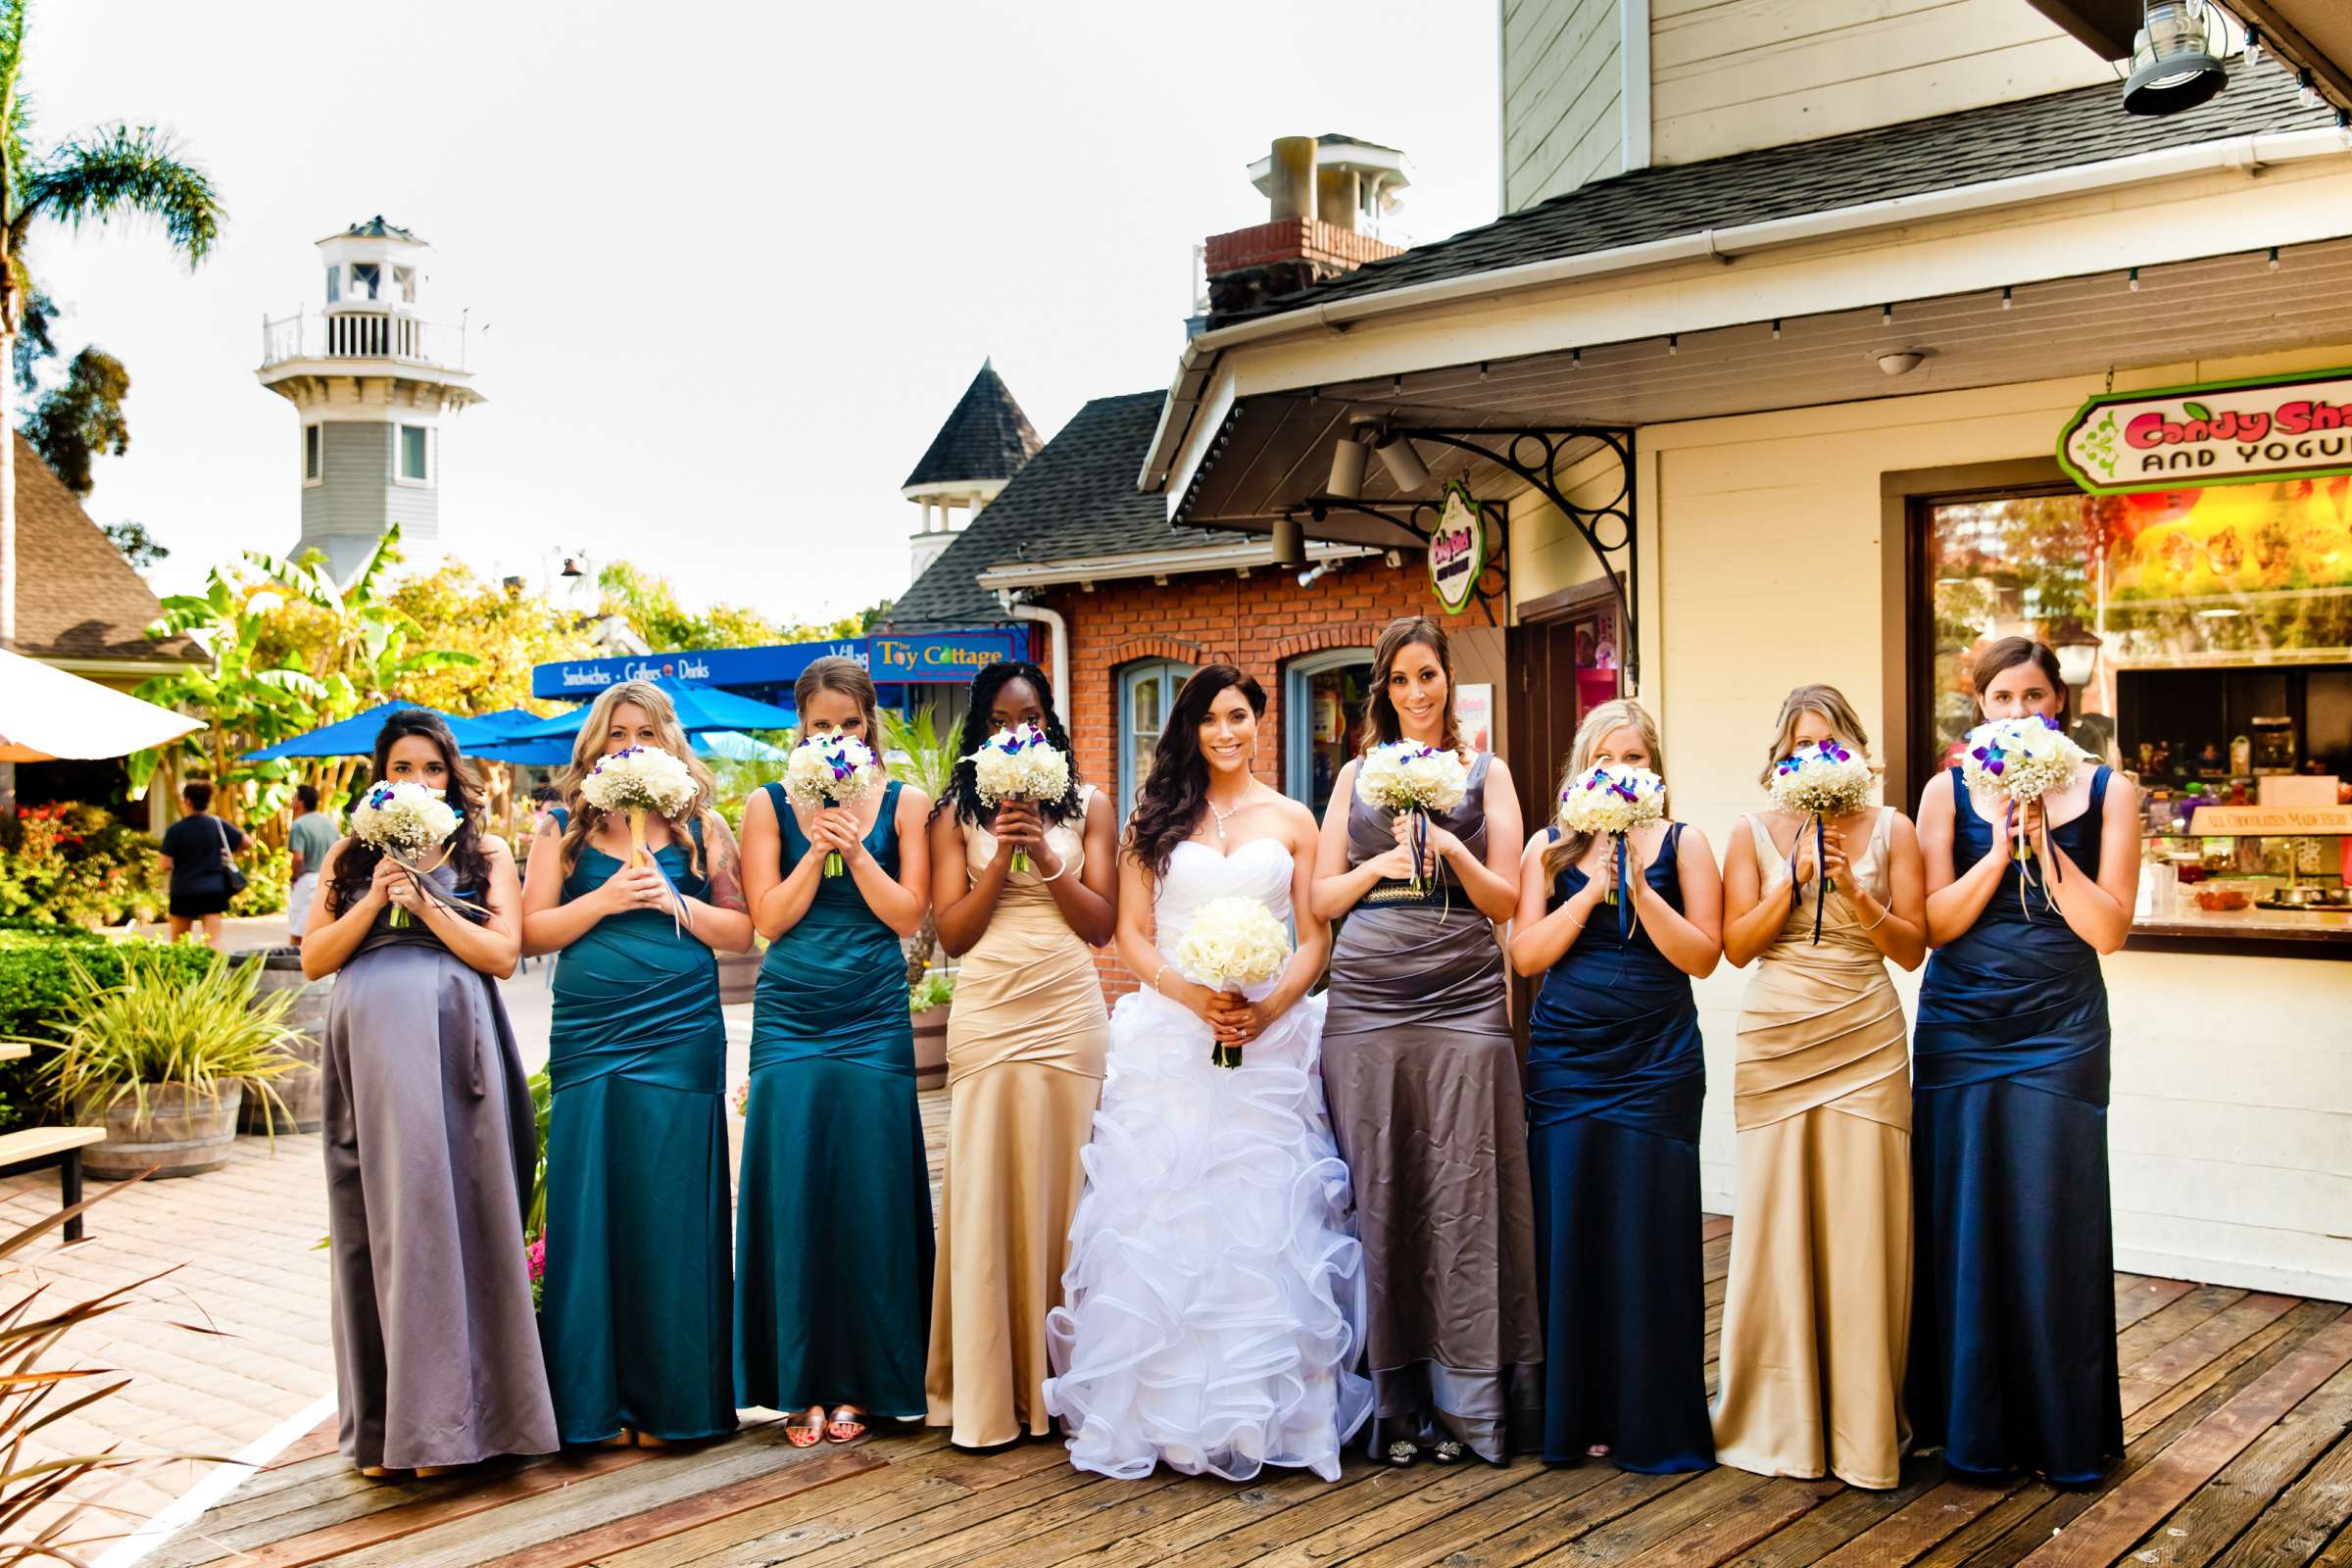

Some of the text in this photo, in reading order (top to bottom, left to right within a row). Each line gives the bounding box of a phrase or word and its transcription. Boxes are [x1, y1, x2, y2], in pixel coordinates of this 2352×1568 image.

[2125, 411, 2271, 450] Candy
[2141, 436, 2352, 472] AND YOGU
[562, 658, 710, 687] Sandwiches Coffees Drinks
